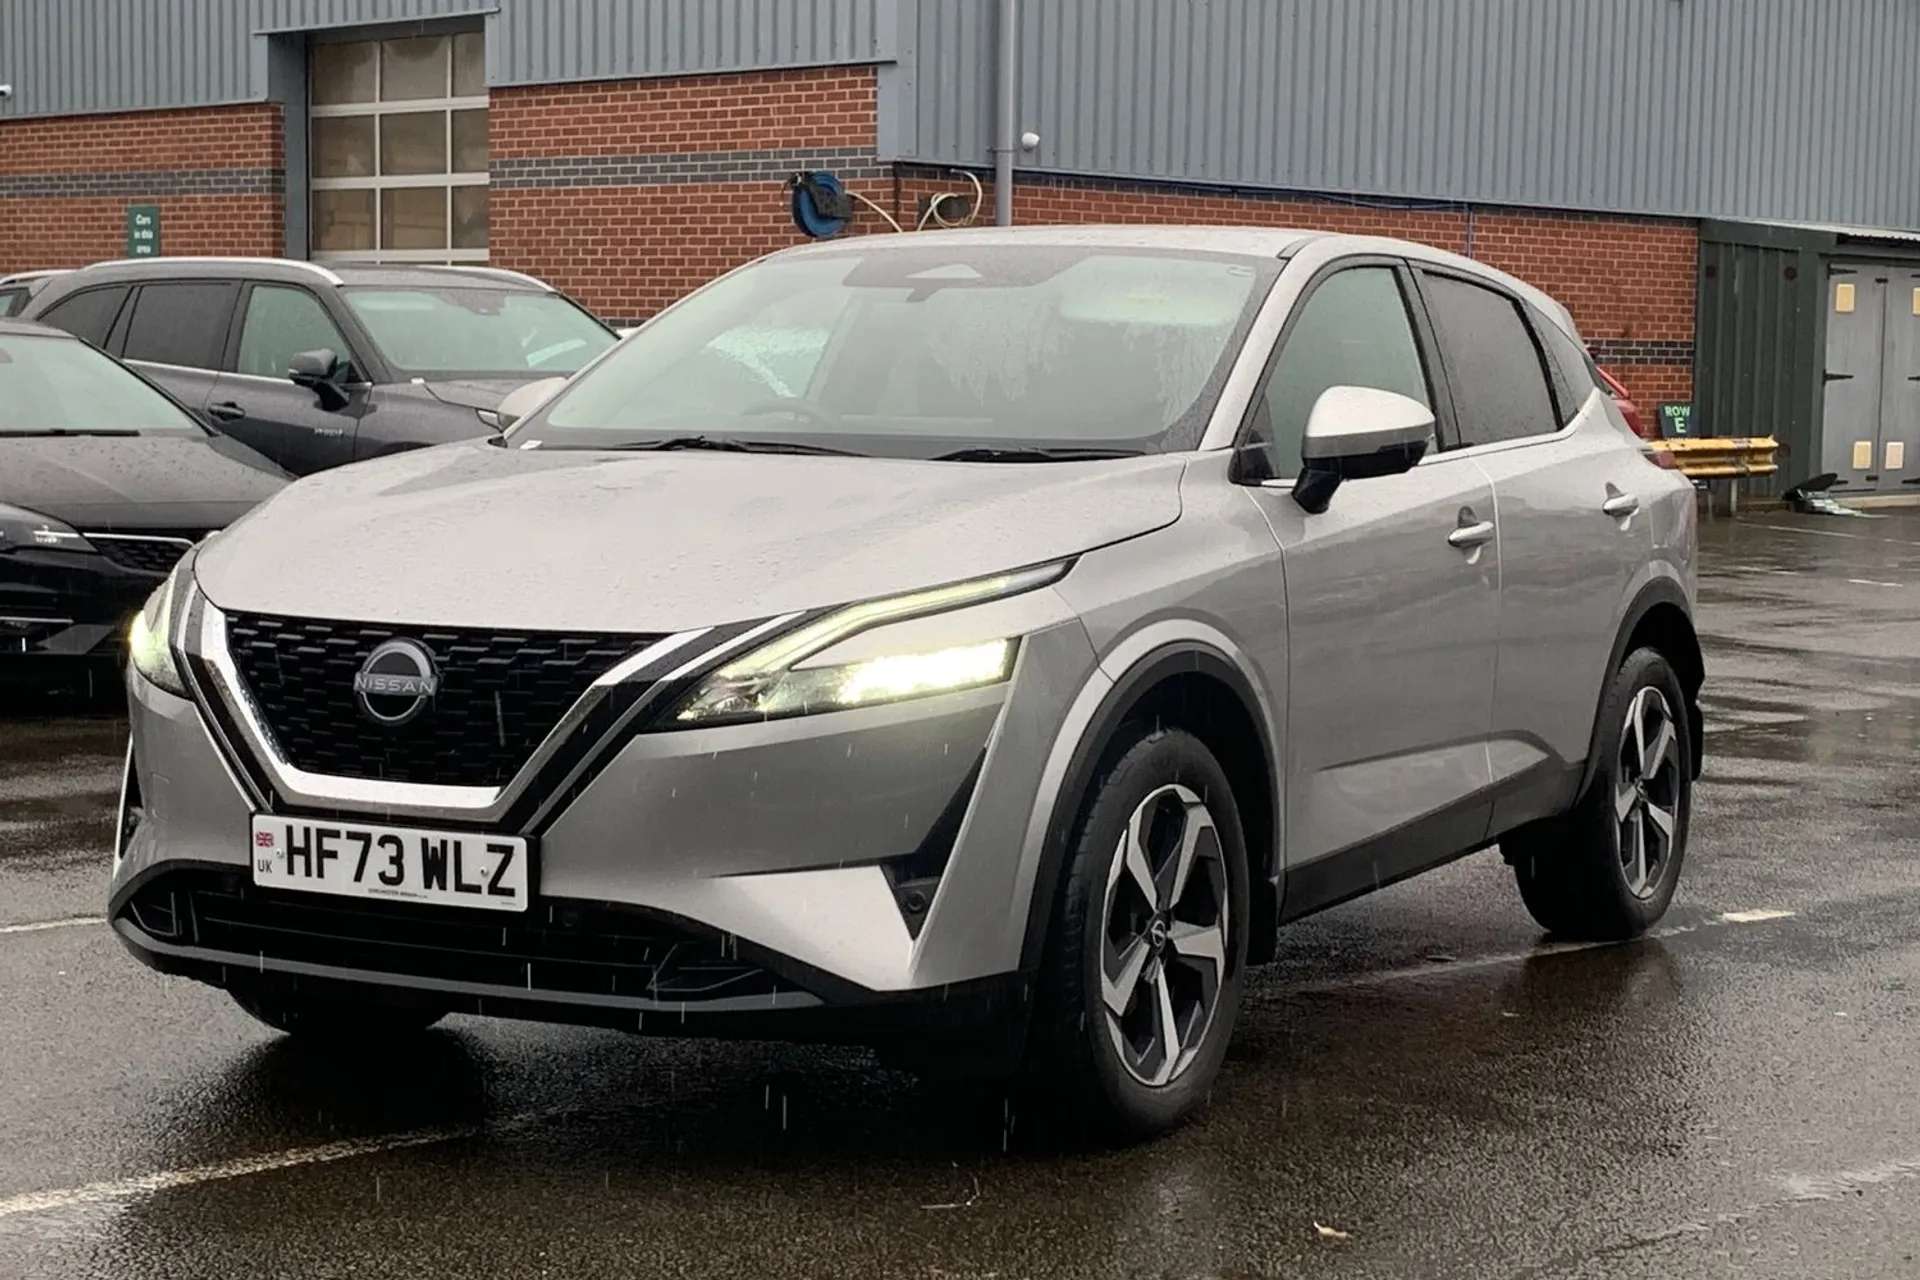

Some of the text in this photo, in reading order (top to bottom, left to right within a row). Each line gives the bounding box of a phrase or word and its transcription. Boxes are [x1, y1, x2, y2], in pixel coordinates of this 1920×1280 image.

[135, 213, 152, 225] Cars
[1664, 405, 1691, 417] ROW
[1674, 417, 1687, 433] E
[354, 673, 434, 694] NISSAN
[257, 859, 273, 874] UK
[286, 825, 516, 898] HF73 WLZ
